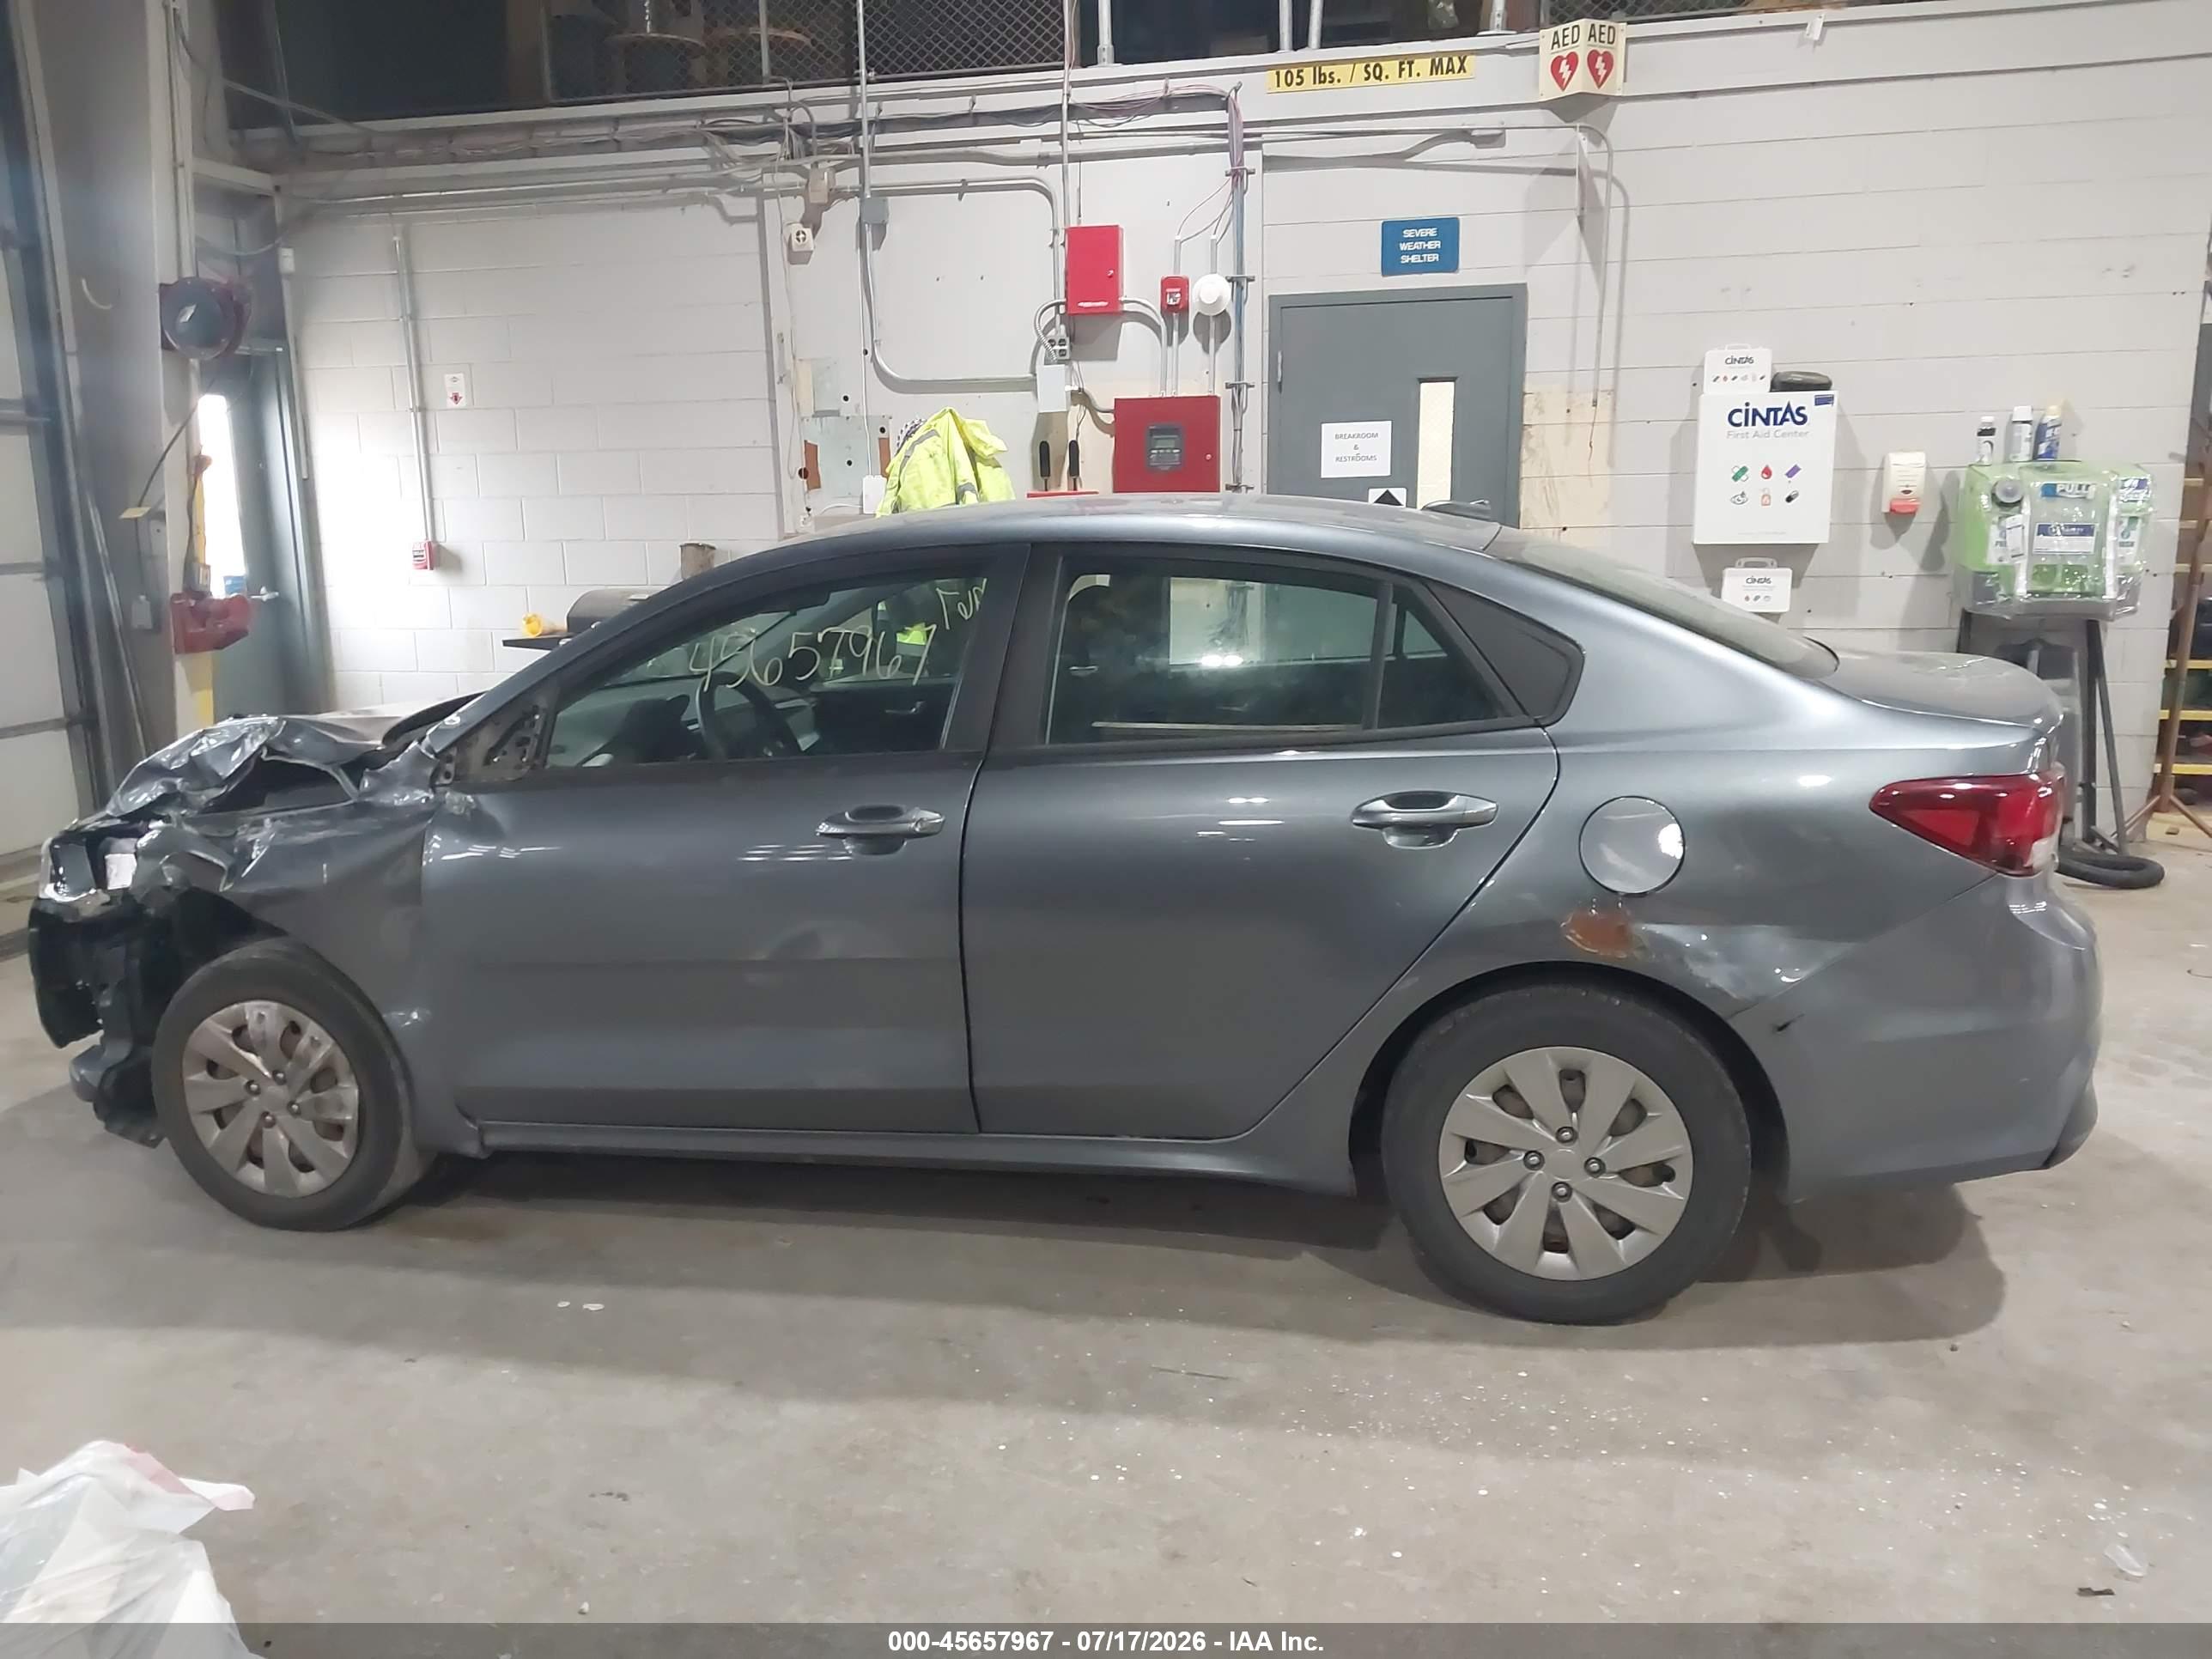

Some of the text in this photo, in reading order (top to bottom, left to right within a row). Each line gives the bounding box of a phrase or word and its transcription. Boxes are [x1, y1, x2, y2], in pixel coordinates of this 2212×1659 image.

[1551, 24, 1580, 50] AED
[1588, 23, 1616, 45] AED
[1274, 55, 1468, 88] 105 lbs. / SQ. FT. MAX
[1402, 228, 1437, 238] SEVERE
[1399, 240, 1441, 251] WEATHER
[1401, 253, 1439, 264] SHELTER
[1726, 429, 1810, 439] First Aid Center
[690, 623, 937, 691] 45657967
